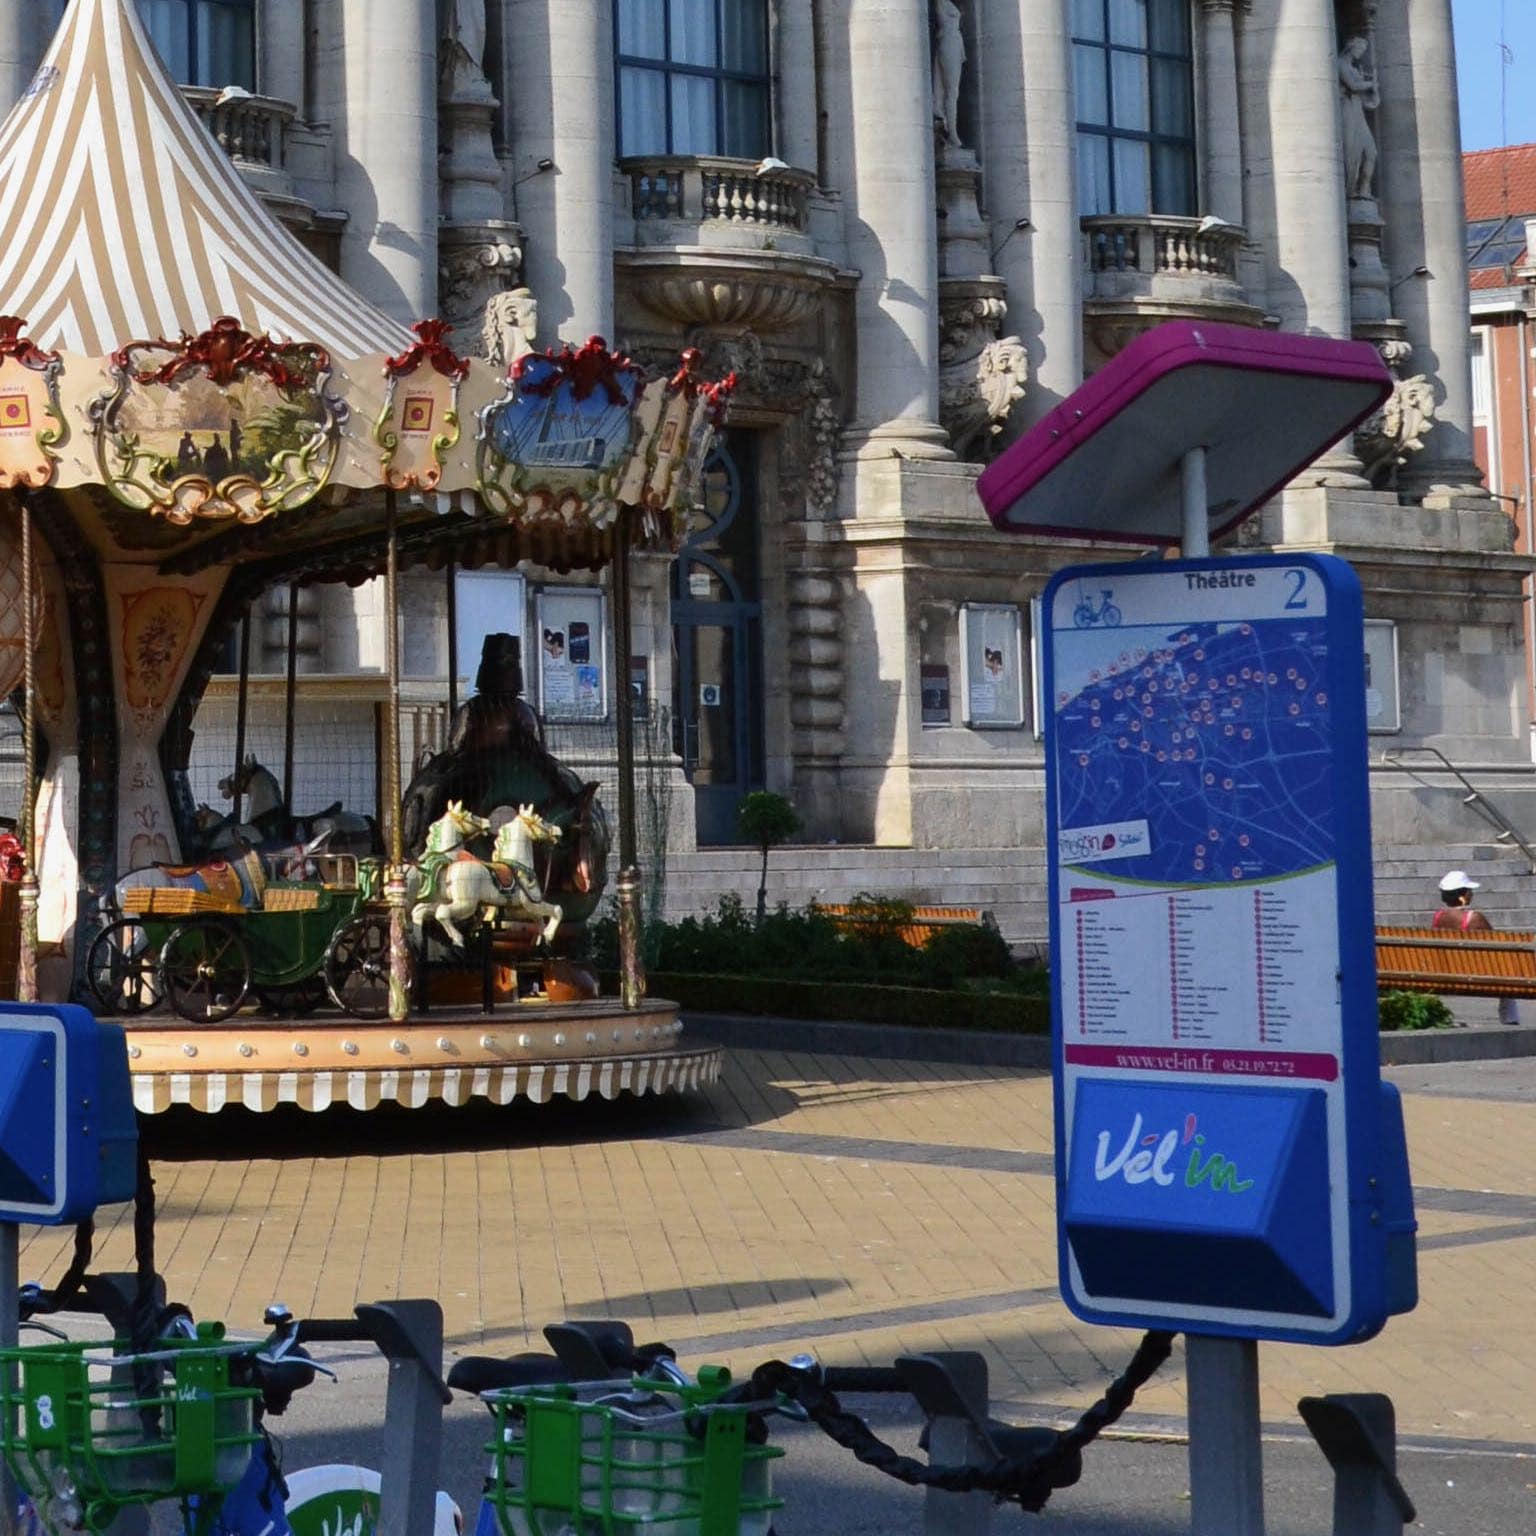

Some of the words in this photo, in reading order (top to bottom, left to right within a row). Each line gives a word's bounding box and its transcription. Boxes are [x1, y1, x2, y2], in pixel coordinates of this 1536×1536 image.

[1184, 569, 1256, 590] Théâtre
[1283, 569, 1307, 609] 2
[1116, 1052, 1214, 1072] www.vel-in.fr
